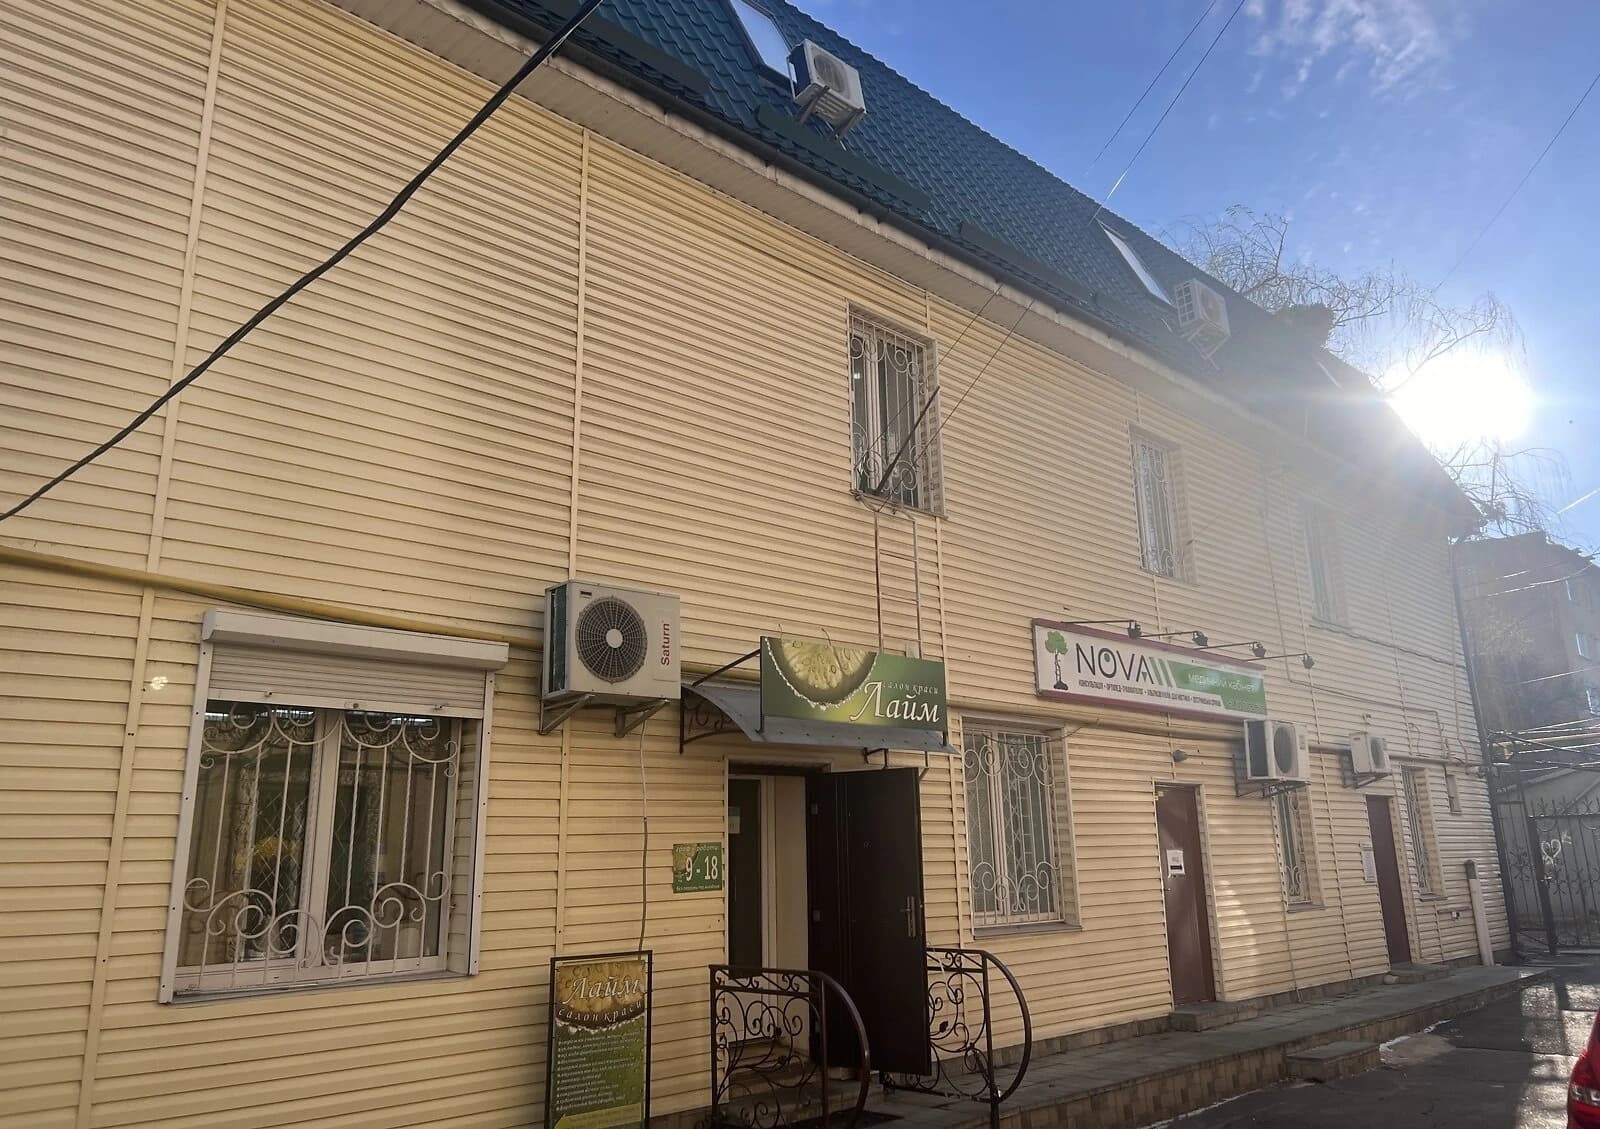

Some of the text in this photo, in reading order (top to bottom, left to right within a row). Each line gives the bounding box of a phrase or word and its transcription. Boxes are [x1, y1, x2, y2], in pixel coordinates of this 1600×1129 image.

[661, 623, 670, 666] Saturn
[1075, 643, 1155, 685] NOVA
[848, 681, 940, 723] Лайм
[912, 685, 939, 697] краси
[685, 856, 693, 882] 9
[704, 855, 718, 880] 18
[562, 975, 639, 1005] Лайм
[558, 1000, 642, 1024] салон краси
